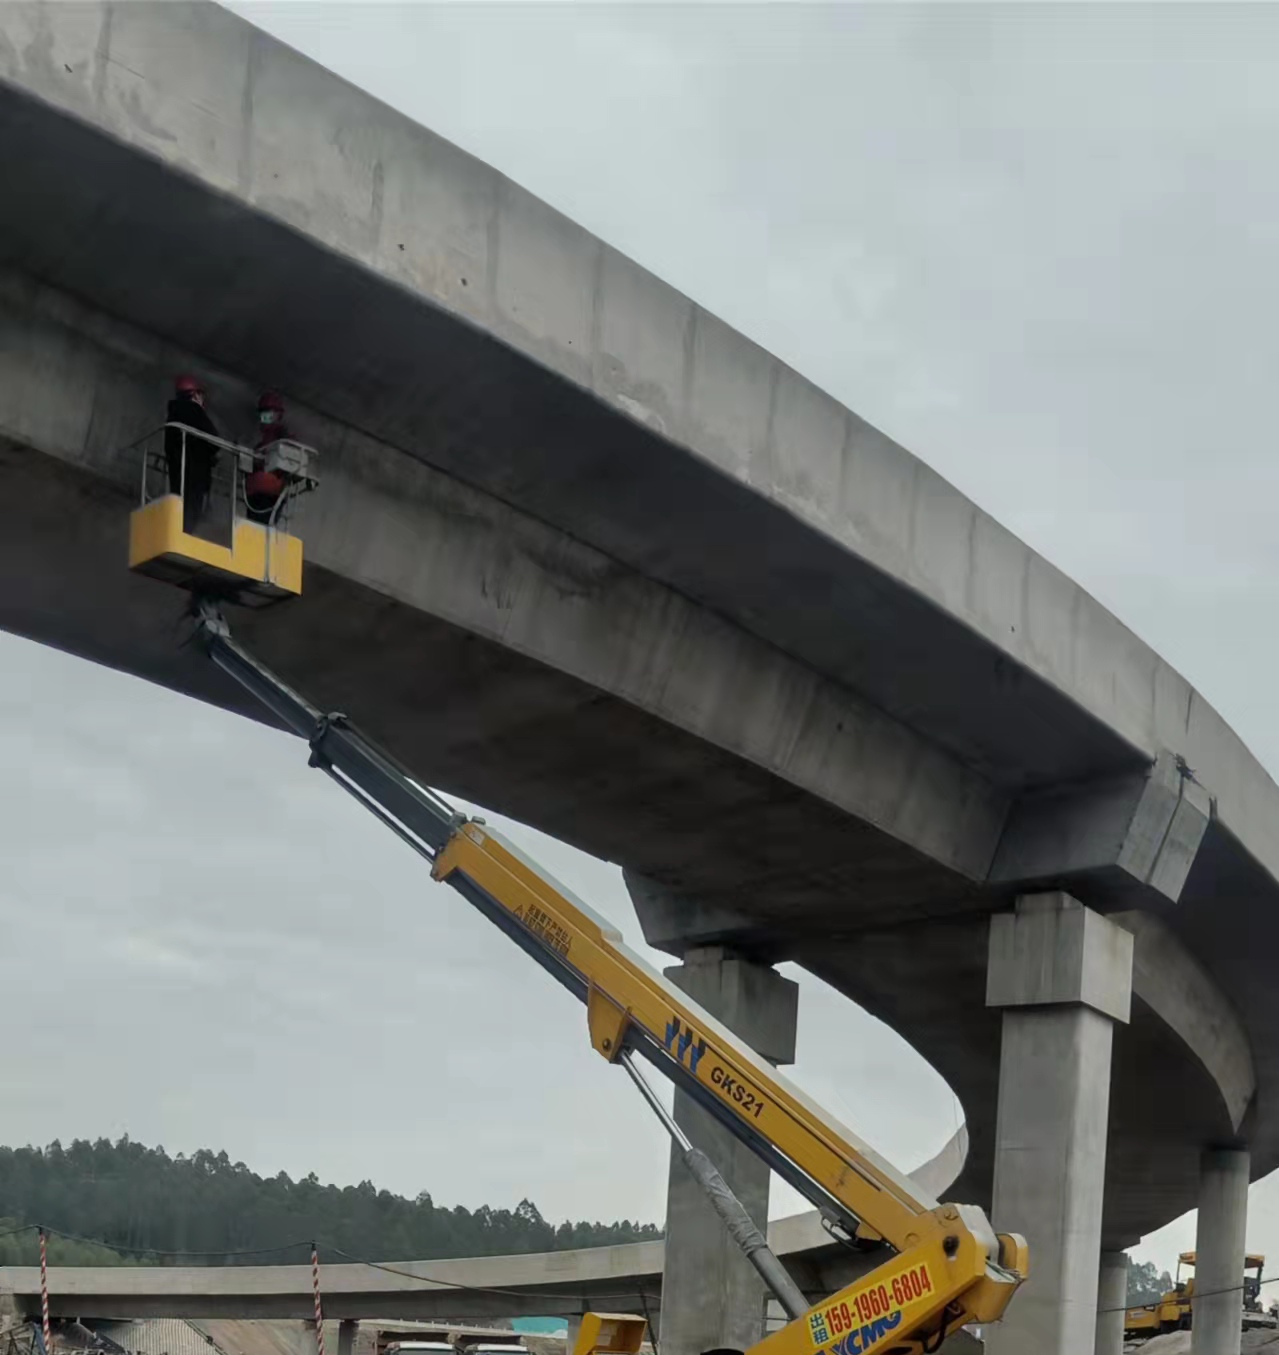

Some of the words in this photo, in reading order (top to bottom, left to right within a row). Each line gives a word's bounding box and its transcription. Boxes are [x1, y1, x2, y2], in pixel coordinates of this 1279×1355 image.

[710, 1066, 764, 1118] GKS21
[824, 1264, 932, 1336] 159-1960-6804
[809, 1312, 829, 1345] 出租
